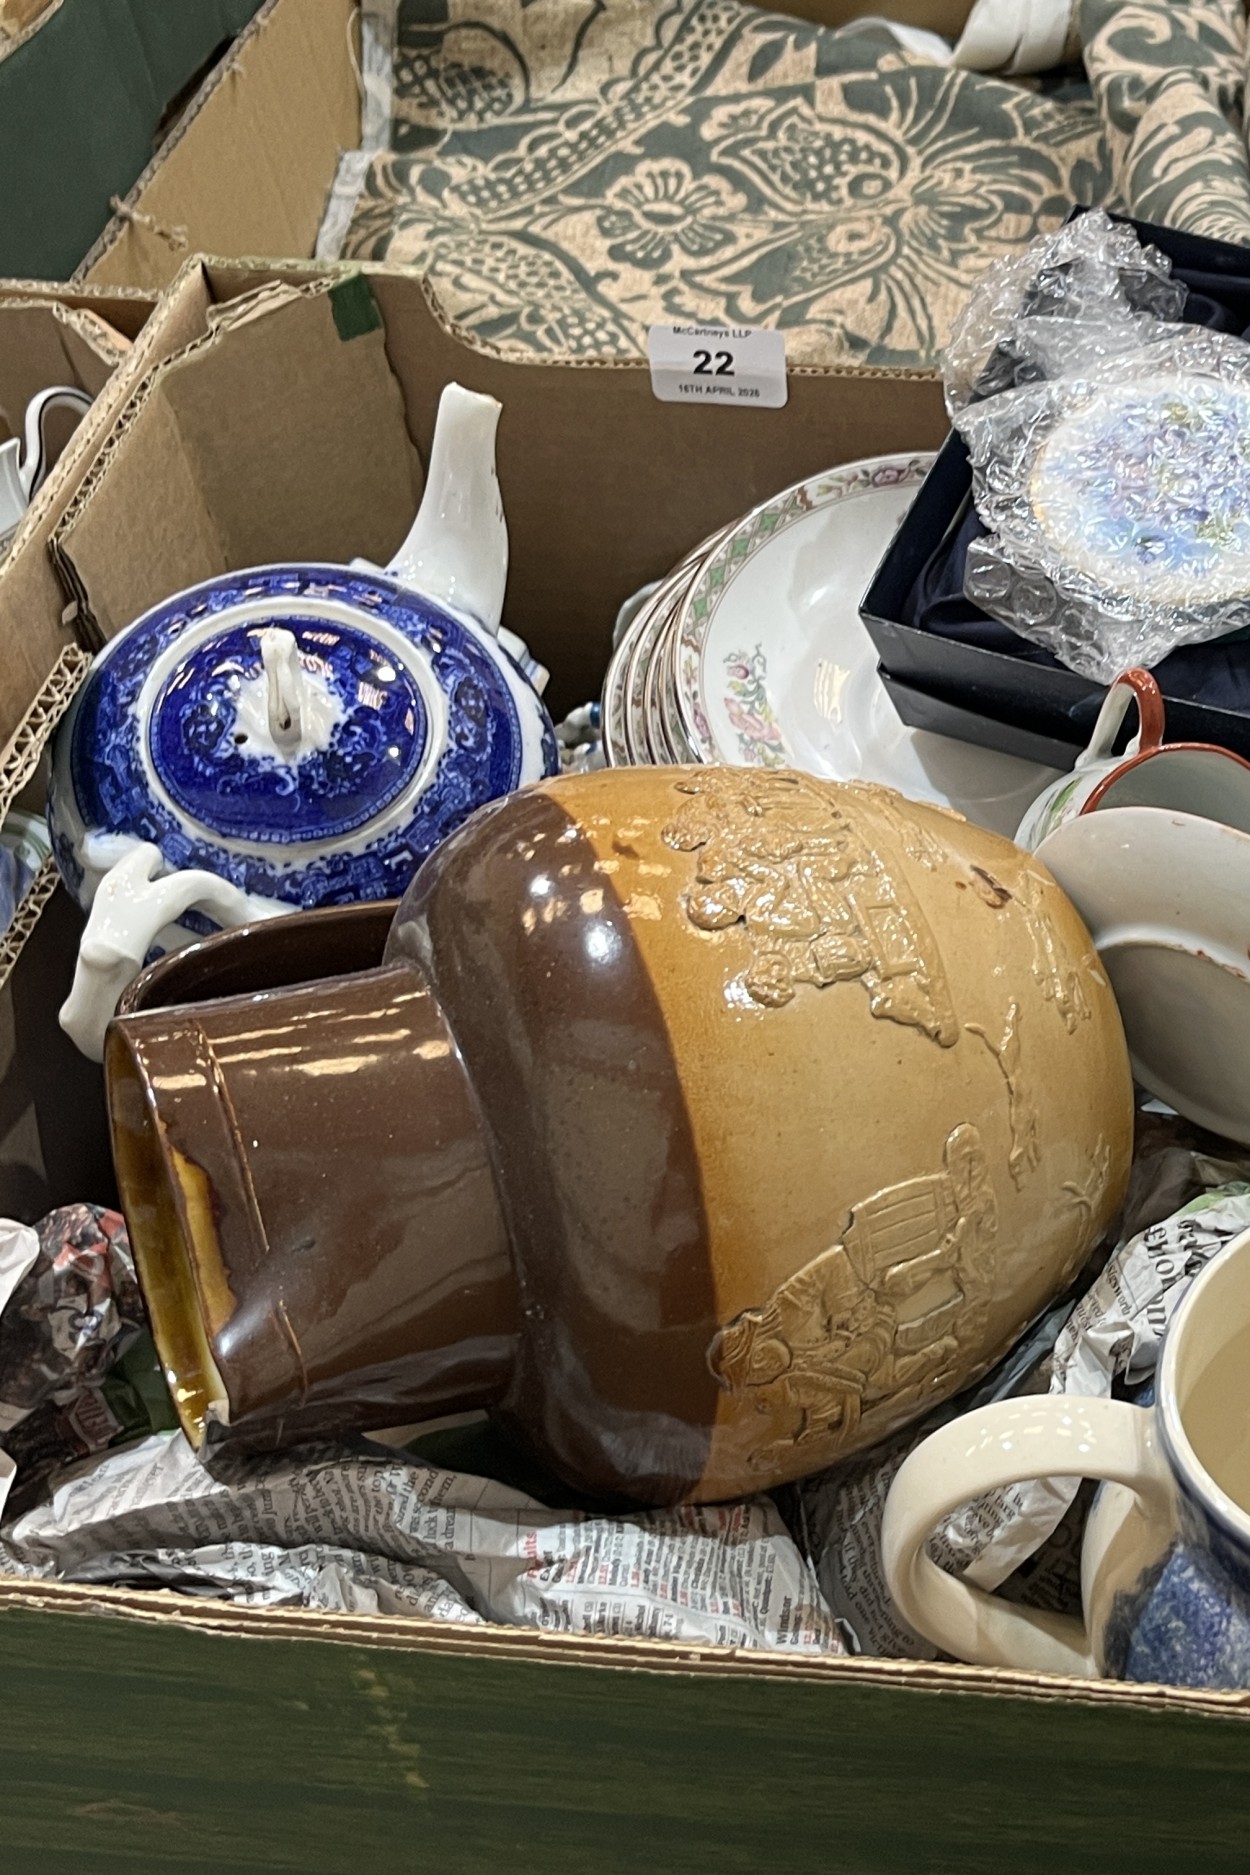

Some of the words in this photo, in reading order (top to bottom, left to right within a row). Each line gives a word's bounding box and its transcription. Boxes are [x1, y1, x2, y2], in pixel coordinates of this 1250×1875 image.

[672, 326, 730, 340] McCartneys
[732, 330, 752, 338] LLP
[693, 350, 735, 376] 22
[678, 384, 703, 394] 16TH
[705, 386, 735, 397] APRIL
[524, 1531, 538, 1579] Rults
[859, 1586, 874, 1606] did
[774, 1595, 793, 1645] Windsor
[855, 1602, 870, 1624] one
